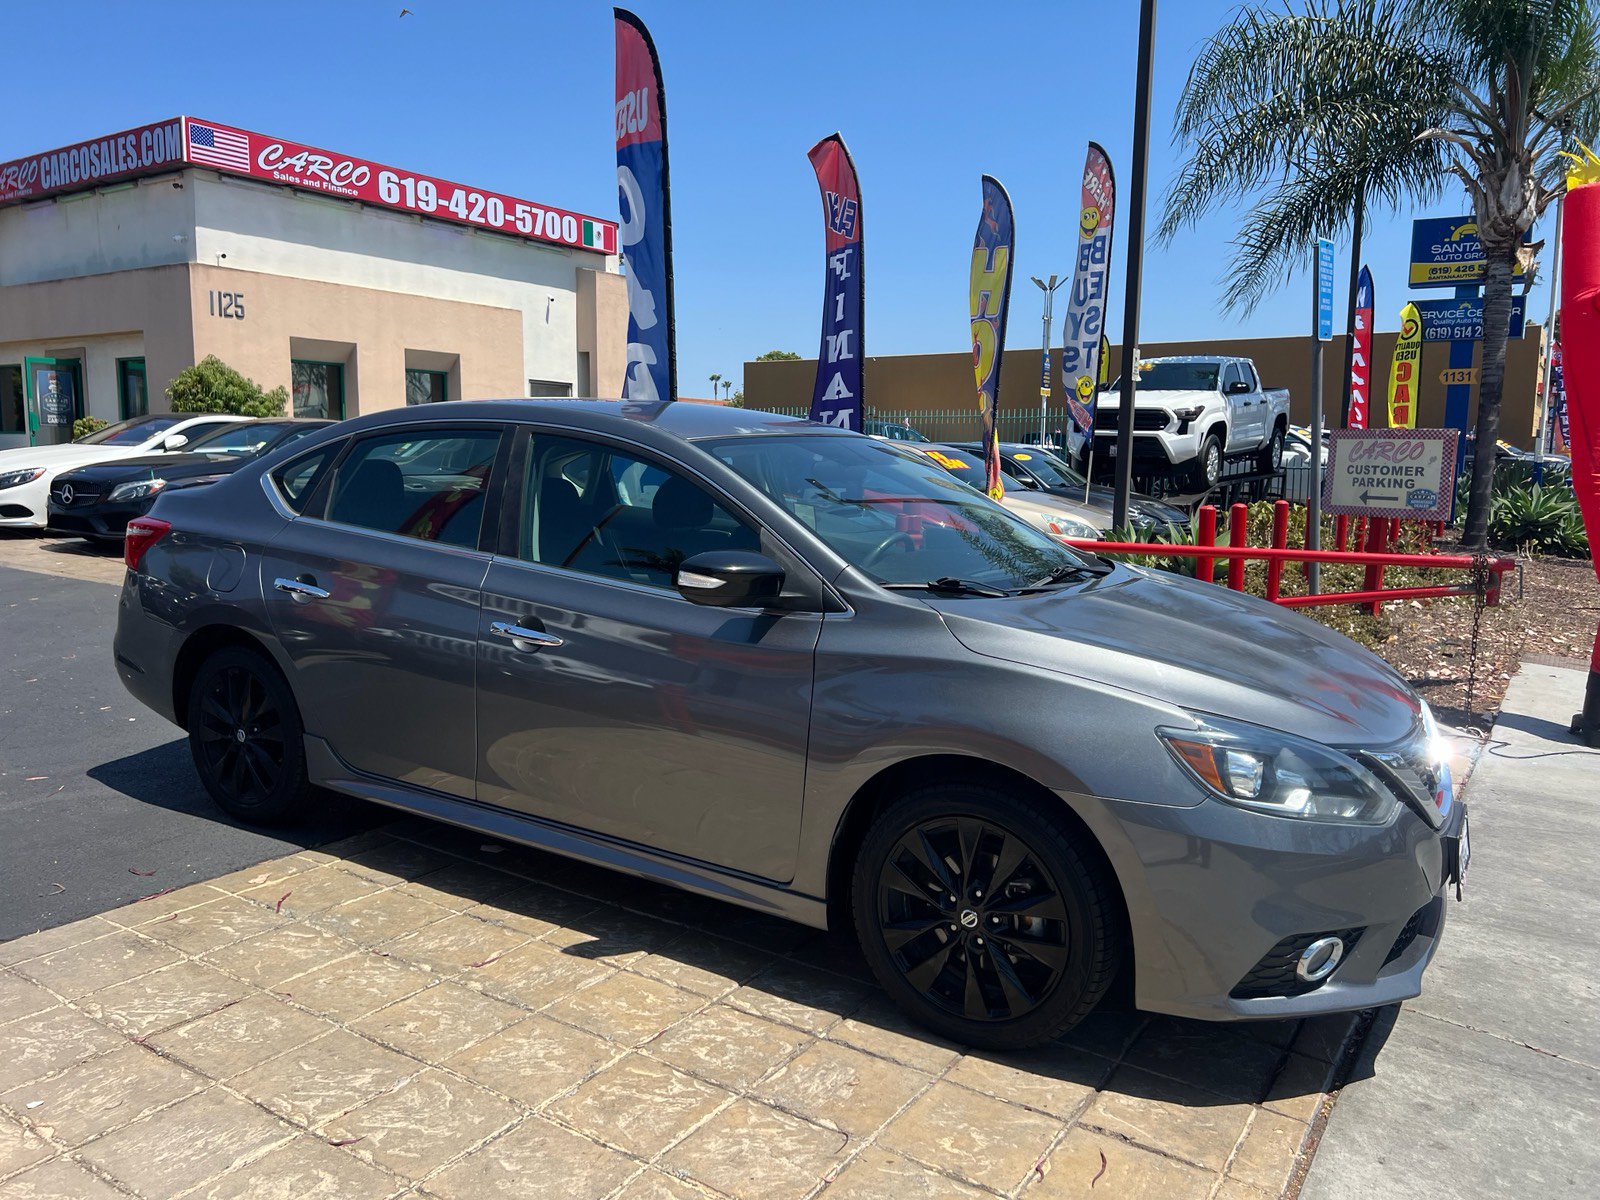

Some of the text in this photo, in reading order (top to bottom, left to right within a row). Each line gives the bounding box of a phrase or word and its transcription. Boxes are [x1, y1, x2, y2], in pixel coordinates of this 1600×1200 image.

[40, 122, 181, 190] CARCOSALES.COM
[257, 144, 370, 187] CARCO
[0, 159, 38, 191] ARCO
[273, 171, 359, 197] Sales and Finance
[378, 170, 578, 244] 619-420-5700
[1431, 242, 1482, 254] SANTA
[1434, 252, 1486, 262] AUTO GRO
[1429, 267, 1452, 275] (619)
[1454, 265, 1475, 273] 426
[209, 290, 245, 320] 1125
[1422, 309, 1464, 319] ERVICE
[1426, 326, 1450, 340] (619)
[1454, 326, 1472, 338] 614
[1442, 371, 1472, 383] 1131
[1348, 440, 1425, 463] CARCO
[1347, 465, 1424, 477] CUSTOMER
[1352, 477, 1415, 489] PARKING
